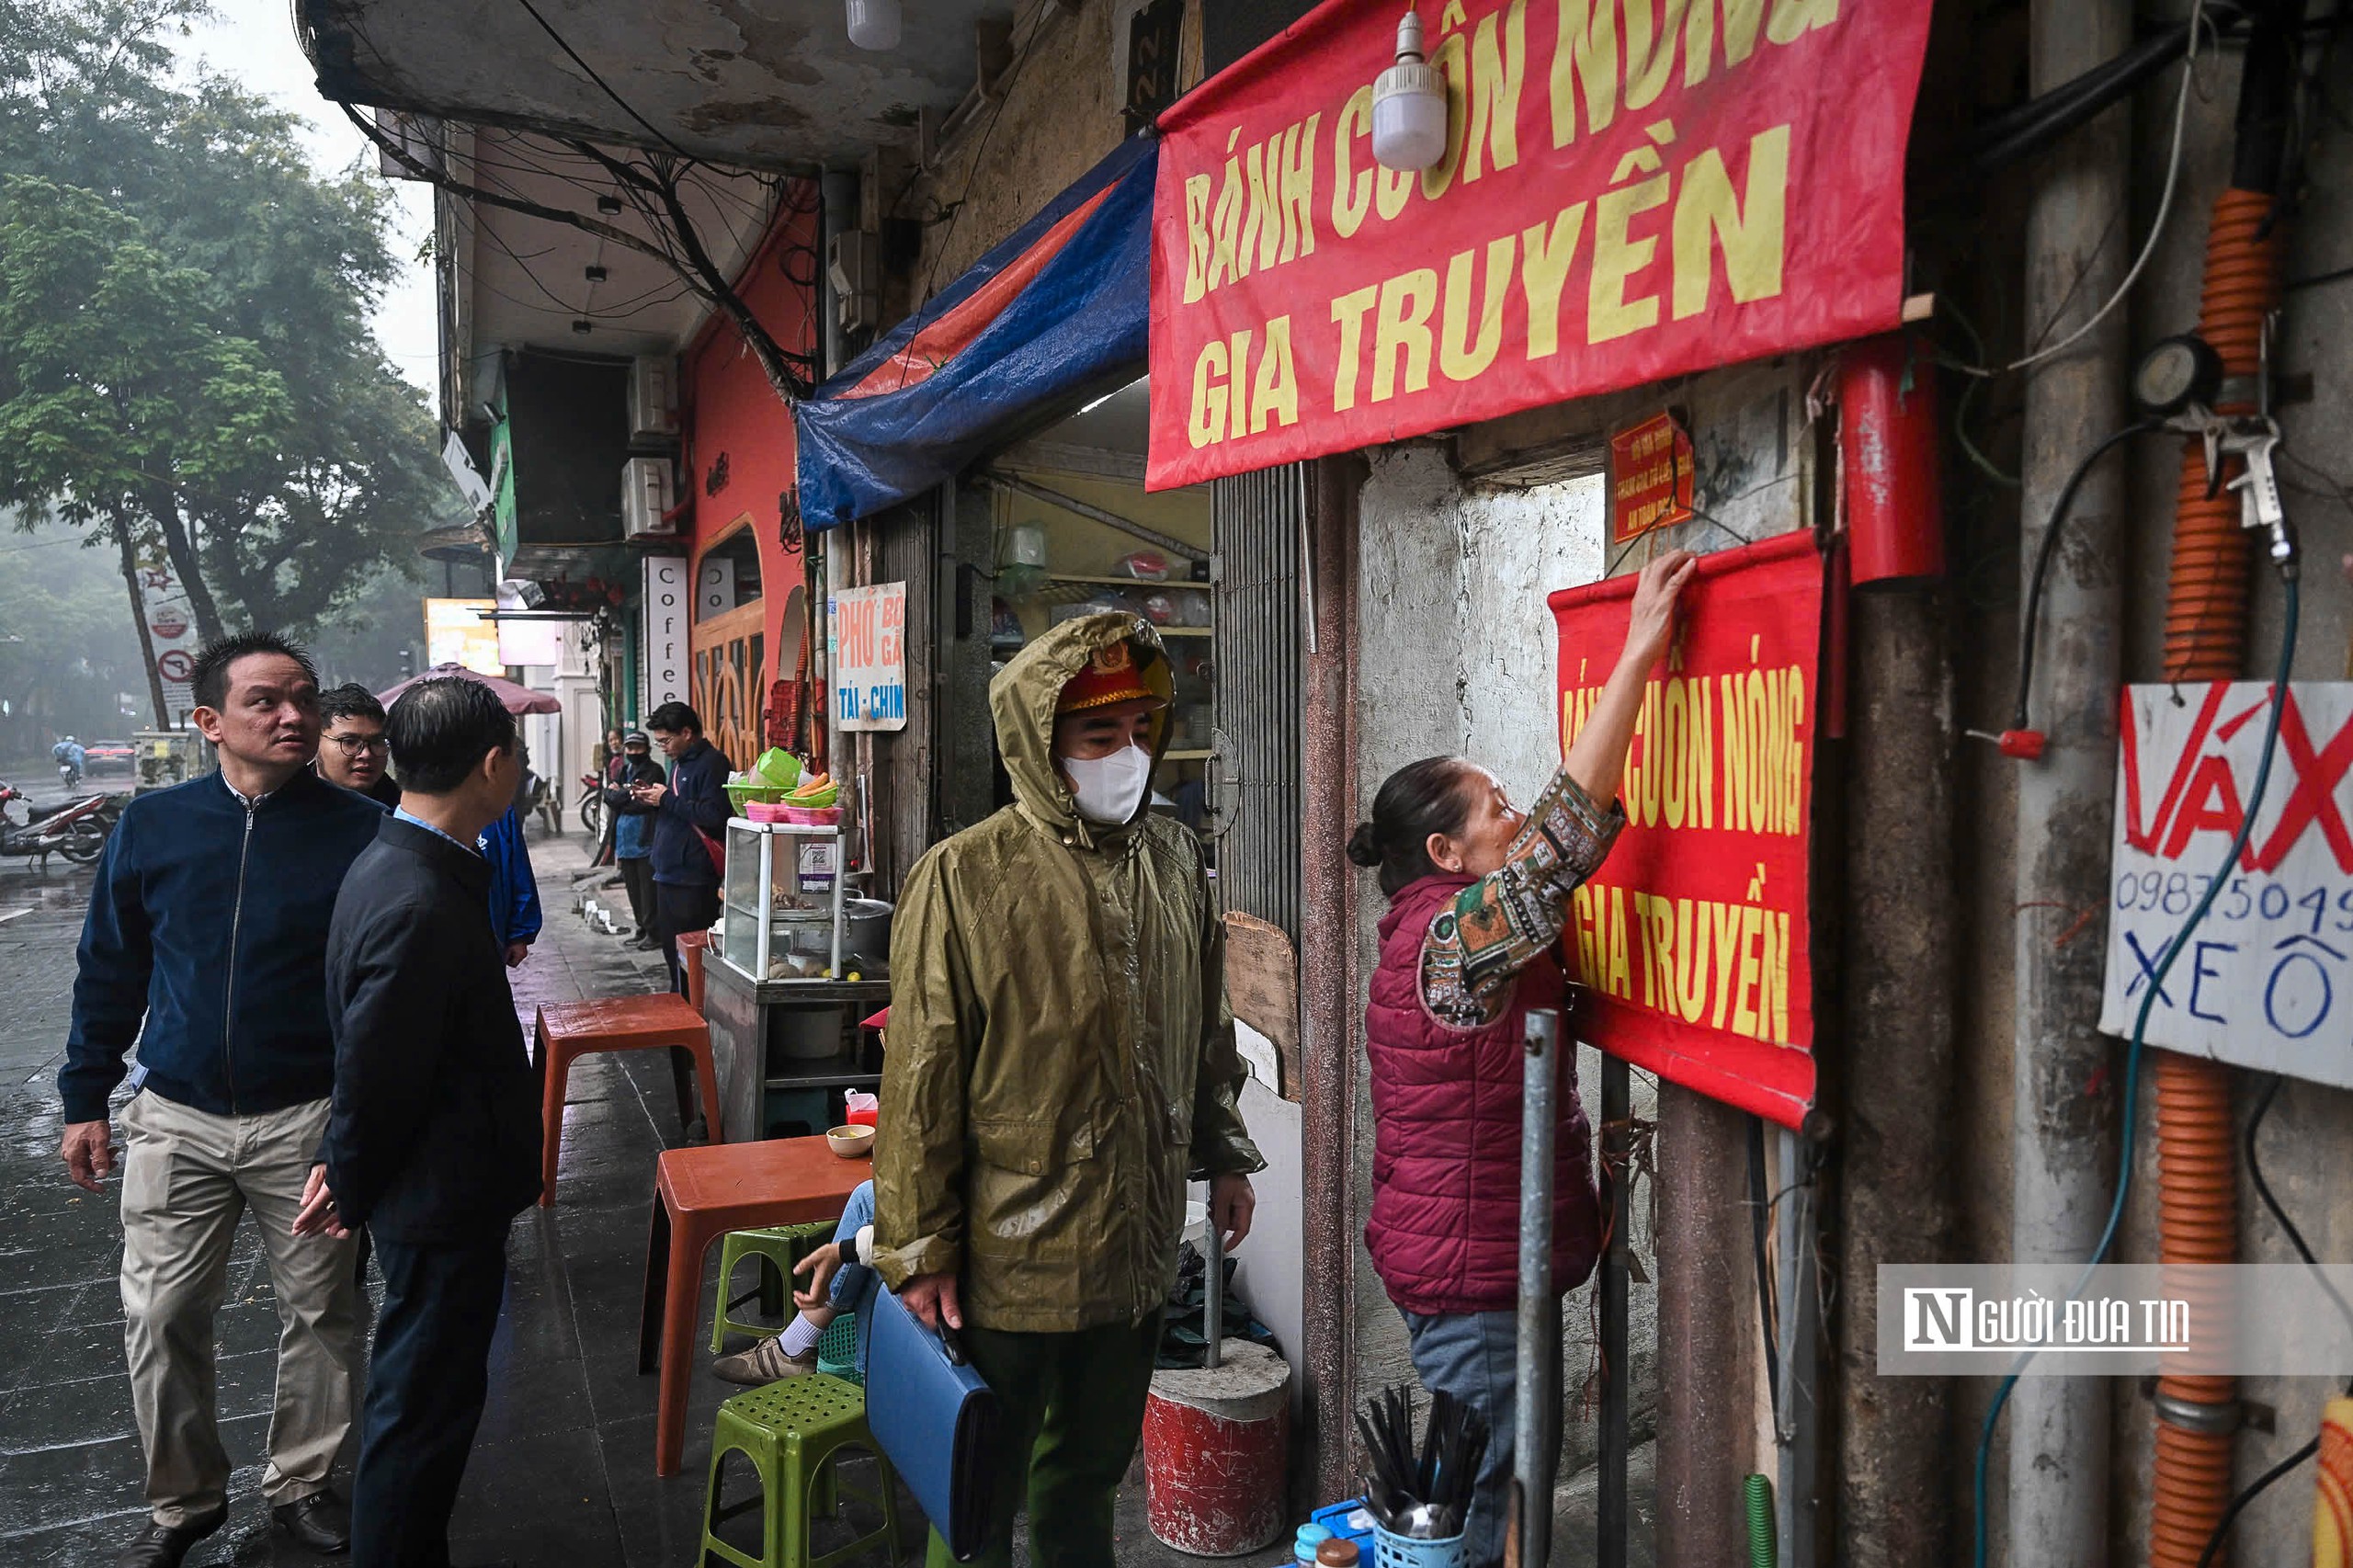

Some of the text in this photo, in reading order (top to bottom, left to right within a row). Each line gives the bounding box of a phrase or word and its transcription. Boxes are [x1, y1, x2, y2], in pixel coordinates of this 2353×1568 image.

[1183, 111, 1321, 304] BÁNH
[1188, 119, 1790, 449] GIA TRUYỀN
[839, 680, 859, 720] TÁI
[870, 677, 904, 721] CHÍN
[1721, 634, 1804, 835] NÓNG
[1574, 862, 1790, 1048] GIA TRUYỀN
[2124, 931, 2347, 1039] XE Ô
